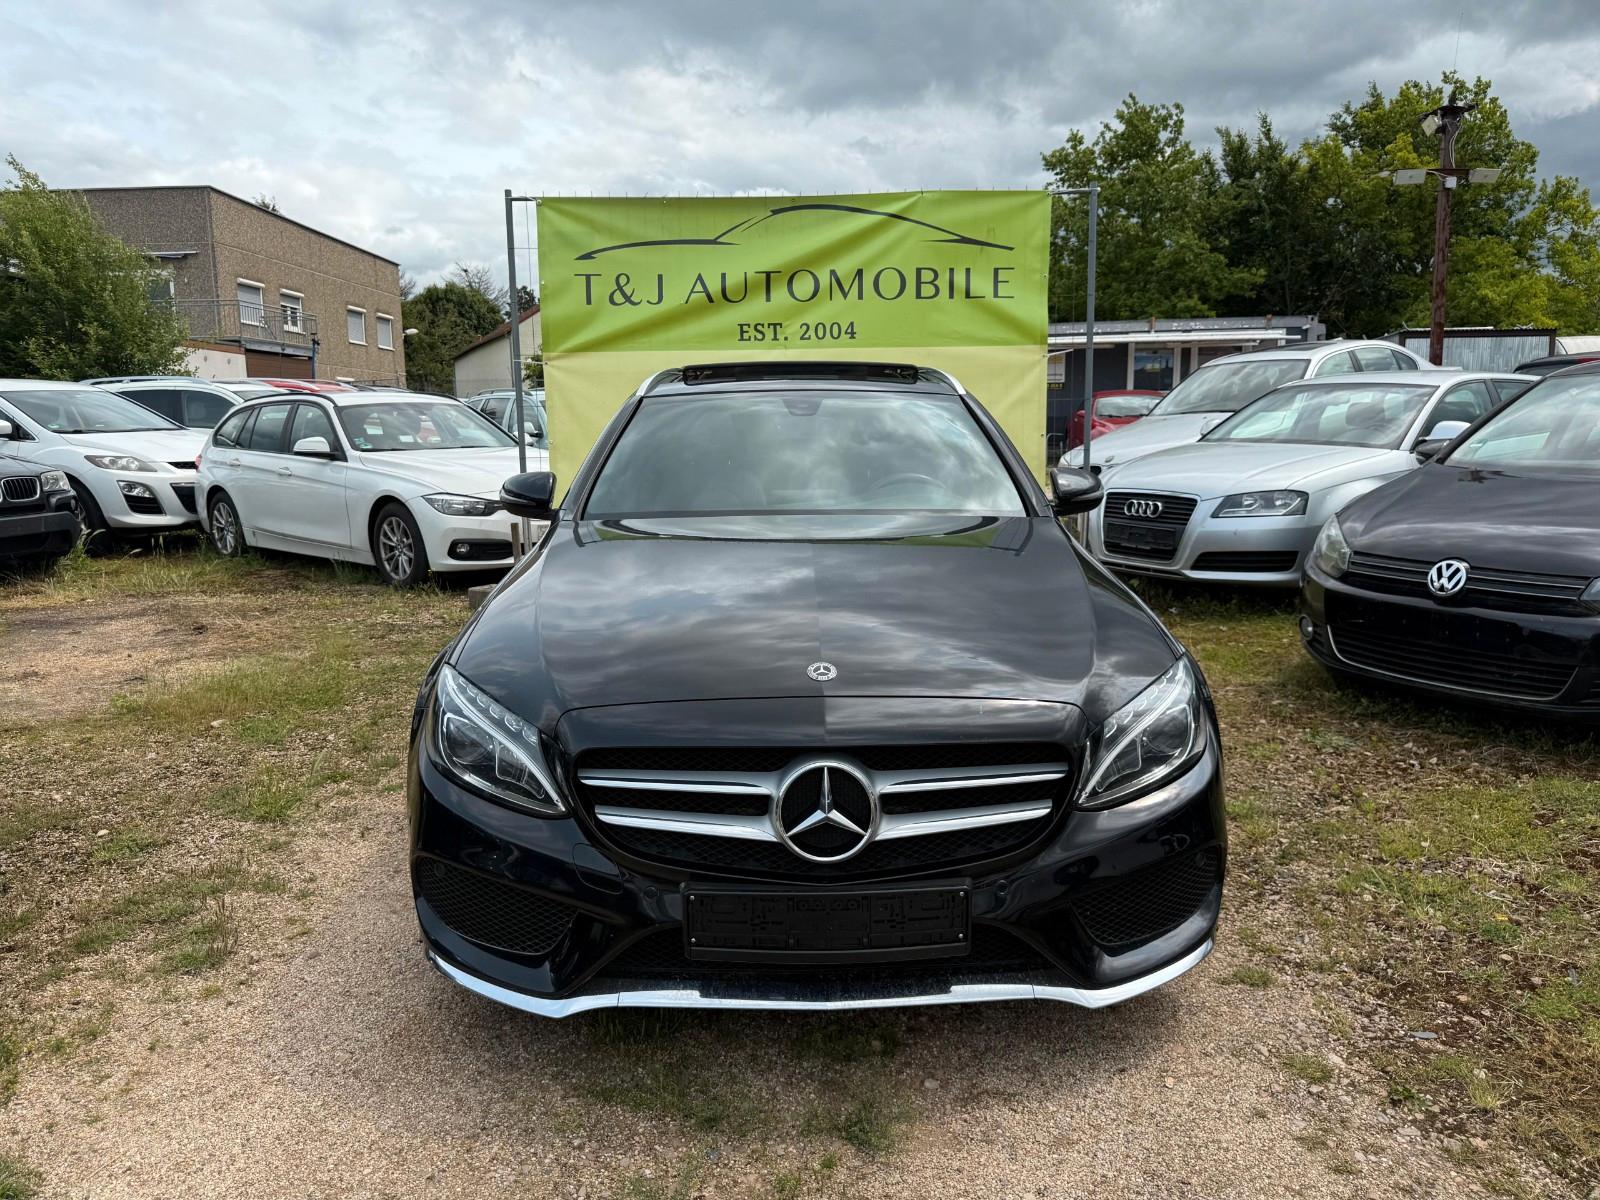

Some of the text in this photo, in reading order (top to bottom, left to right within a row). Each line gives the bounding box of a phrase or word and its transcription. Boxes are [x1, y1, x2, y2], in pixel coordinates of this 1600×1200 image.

[574, 266, 1015, 306] T&J AUTOMOBILE
[737, 321, 857, 342] EST. 2004
[1428, 560, 1467, 595] VW
